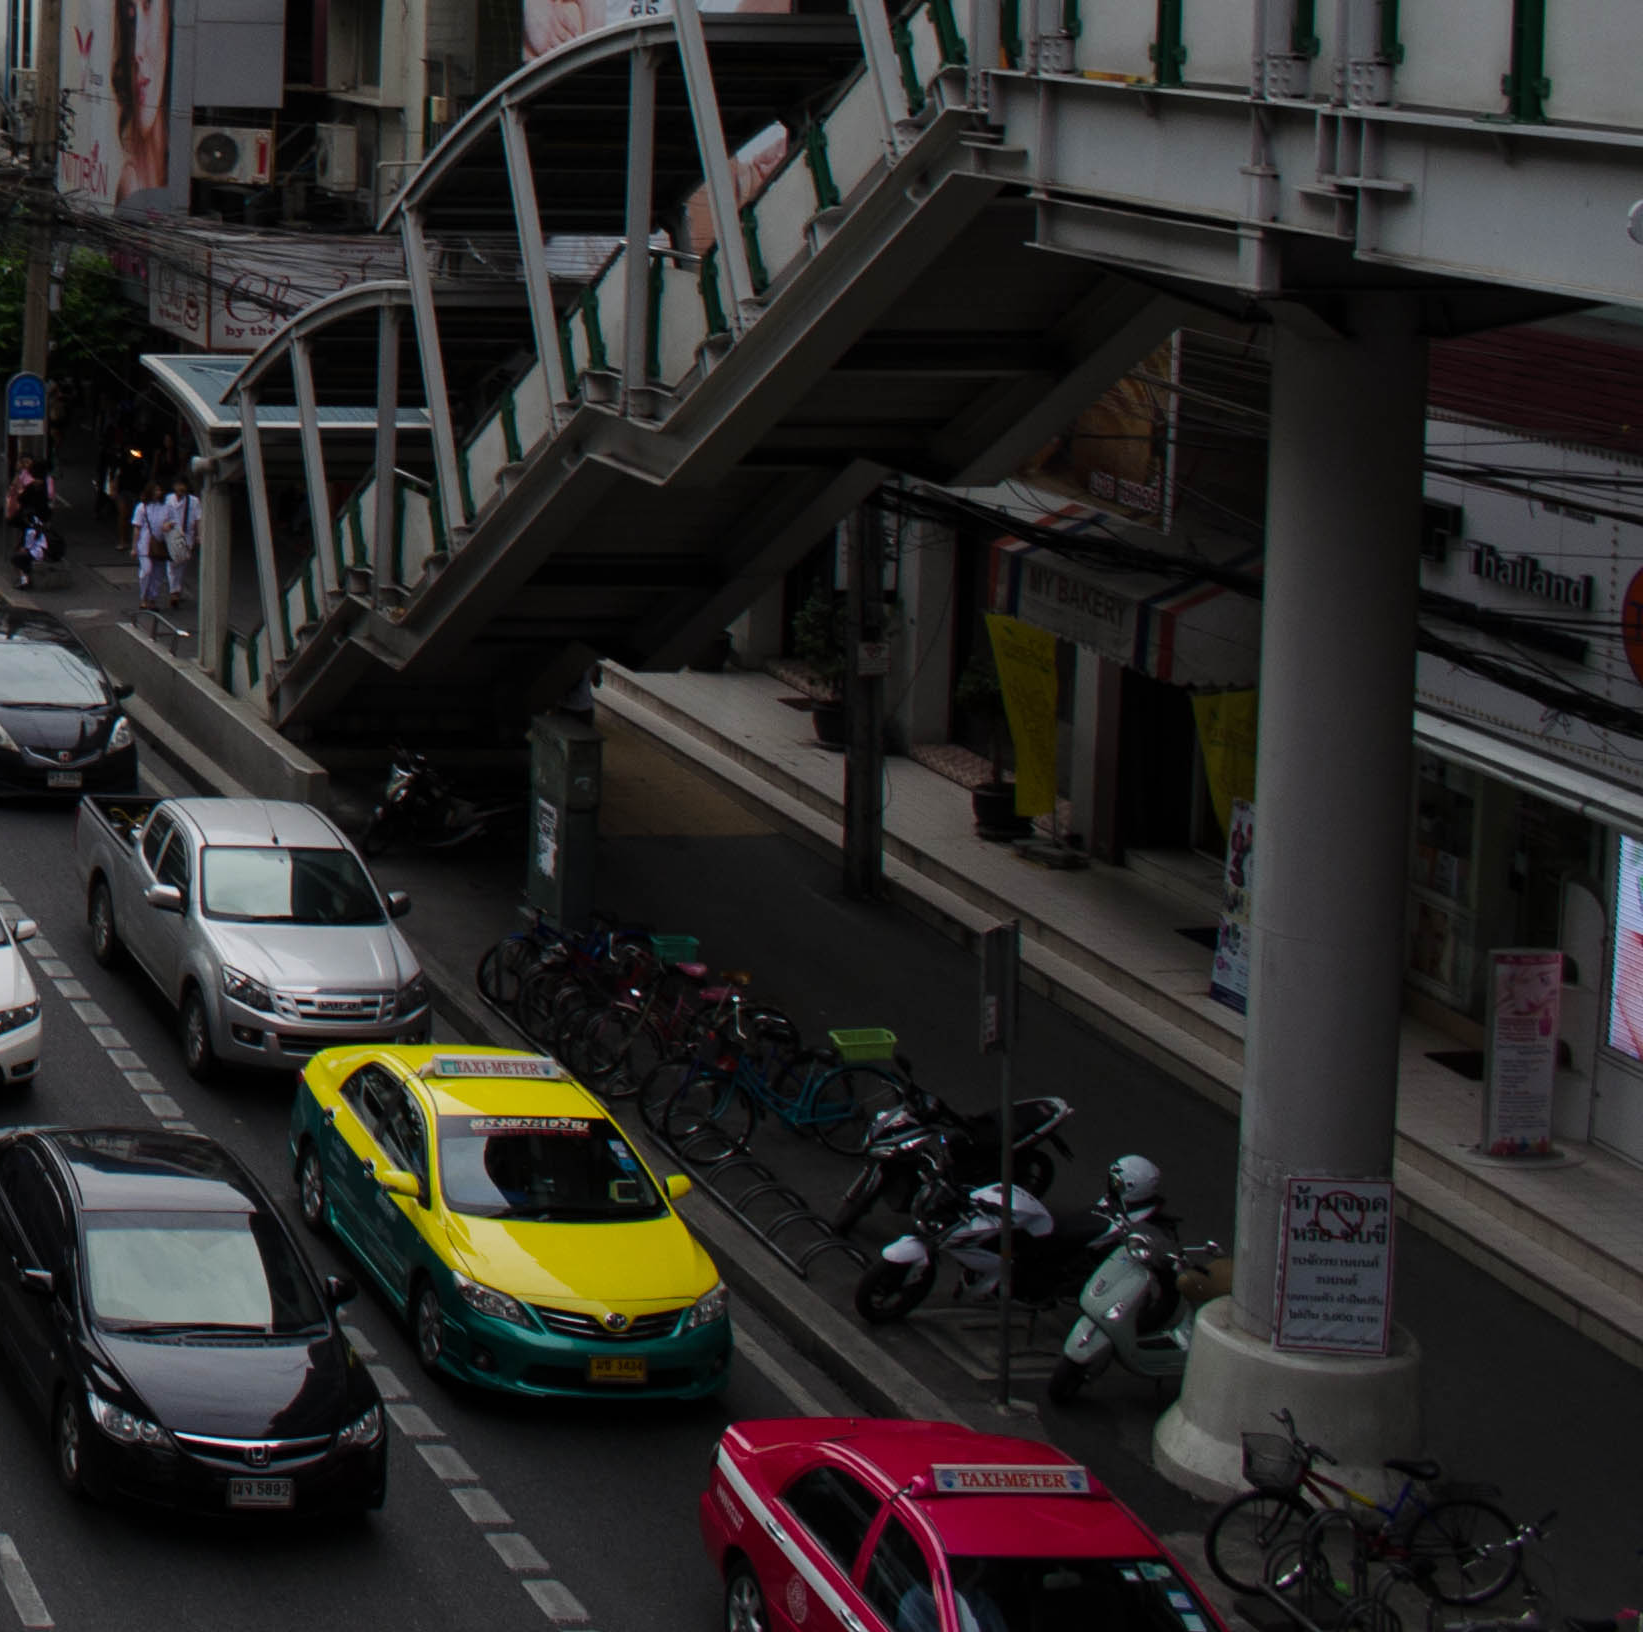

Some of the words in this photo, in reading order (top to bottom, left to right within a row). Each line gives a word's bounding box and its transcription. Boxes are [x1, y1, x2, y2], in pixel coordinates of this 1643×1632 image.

[225, 325, 245, 337] by
[1466, 539, 1594, 610] Thailand
[1029, 565, 1054, 596] MY
[1057, 575, 1126, 628] BAKERY
[455, 1060, 541, 1076] TAXI-METER
[1291, 1185, 1388, 1212] ห้ามจอด
[957, 1472, 1066, 1489] TAXI-METER
